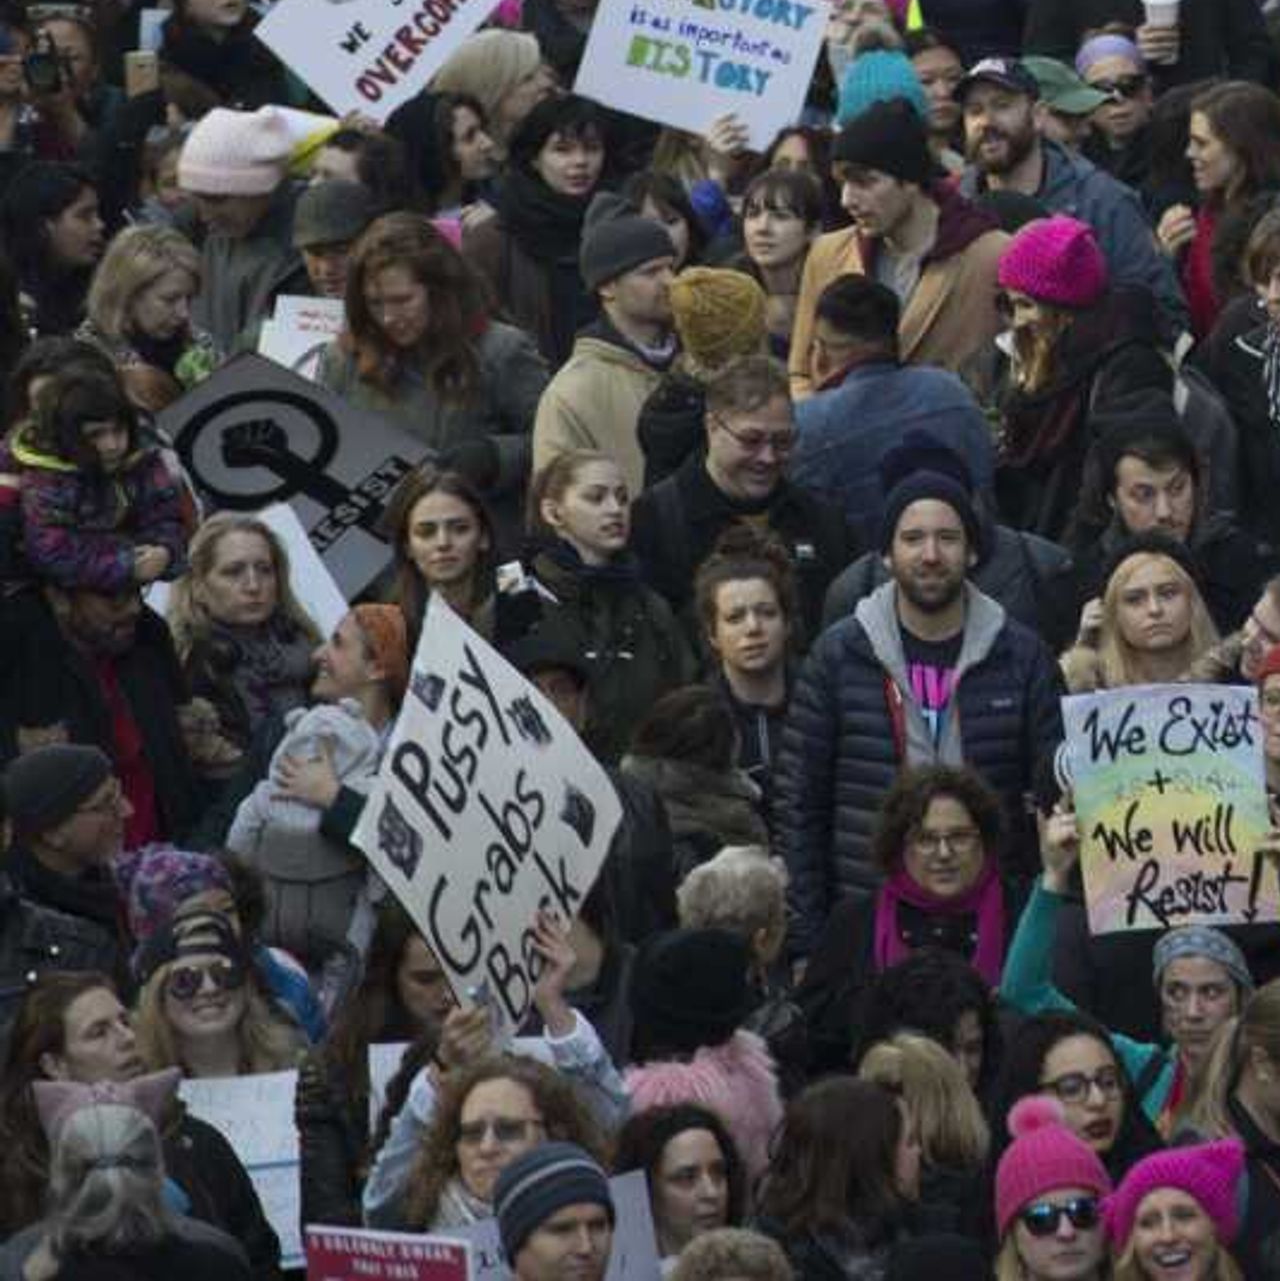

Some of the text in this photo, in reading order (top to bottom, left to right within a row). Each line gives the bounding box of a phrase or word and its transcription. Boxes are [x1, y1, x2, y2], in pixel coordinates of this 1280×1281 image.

[337, 20, 370, 58] WE
[1082, 696, 1260, 762] We Exist
[1091, 801, 1154, 861] We
[426, 768, 545, 976] Grabs
